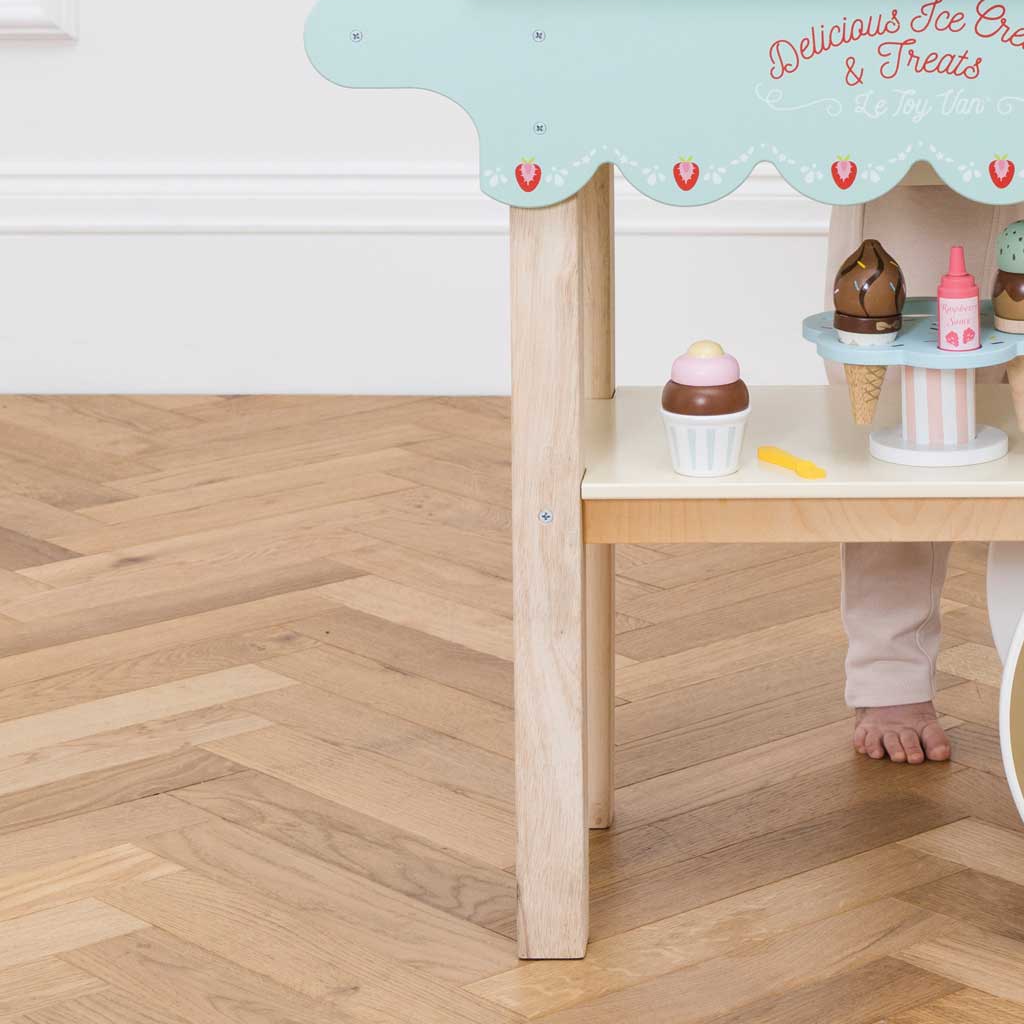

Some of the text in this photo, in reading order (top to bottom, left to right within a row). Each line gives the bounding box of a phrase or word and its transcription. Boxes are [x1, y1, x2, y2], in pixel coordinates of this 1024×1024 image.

[769, 9, 901, 80] Delicious
[844, 38, 982, 87] & Treats
[854, 87, 985, 124] Le Toy Van
